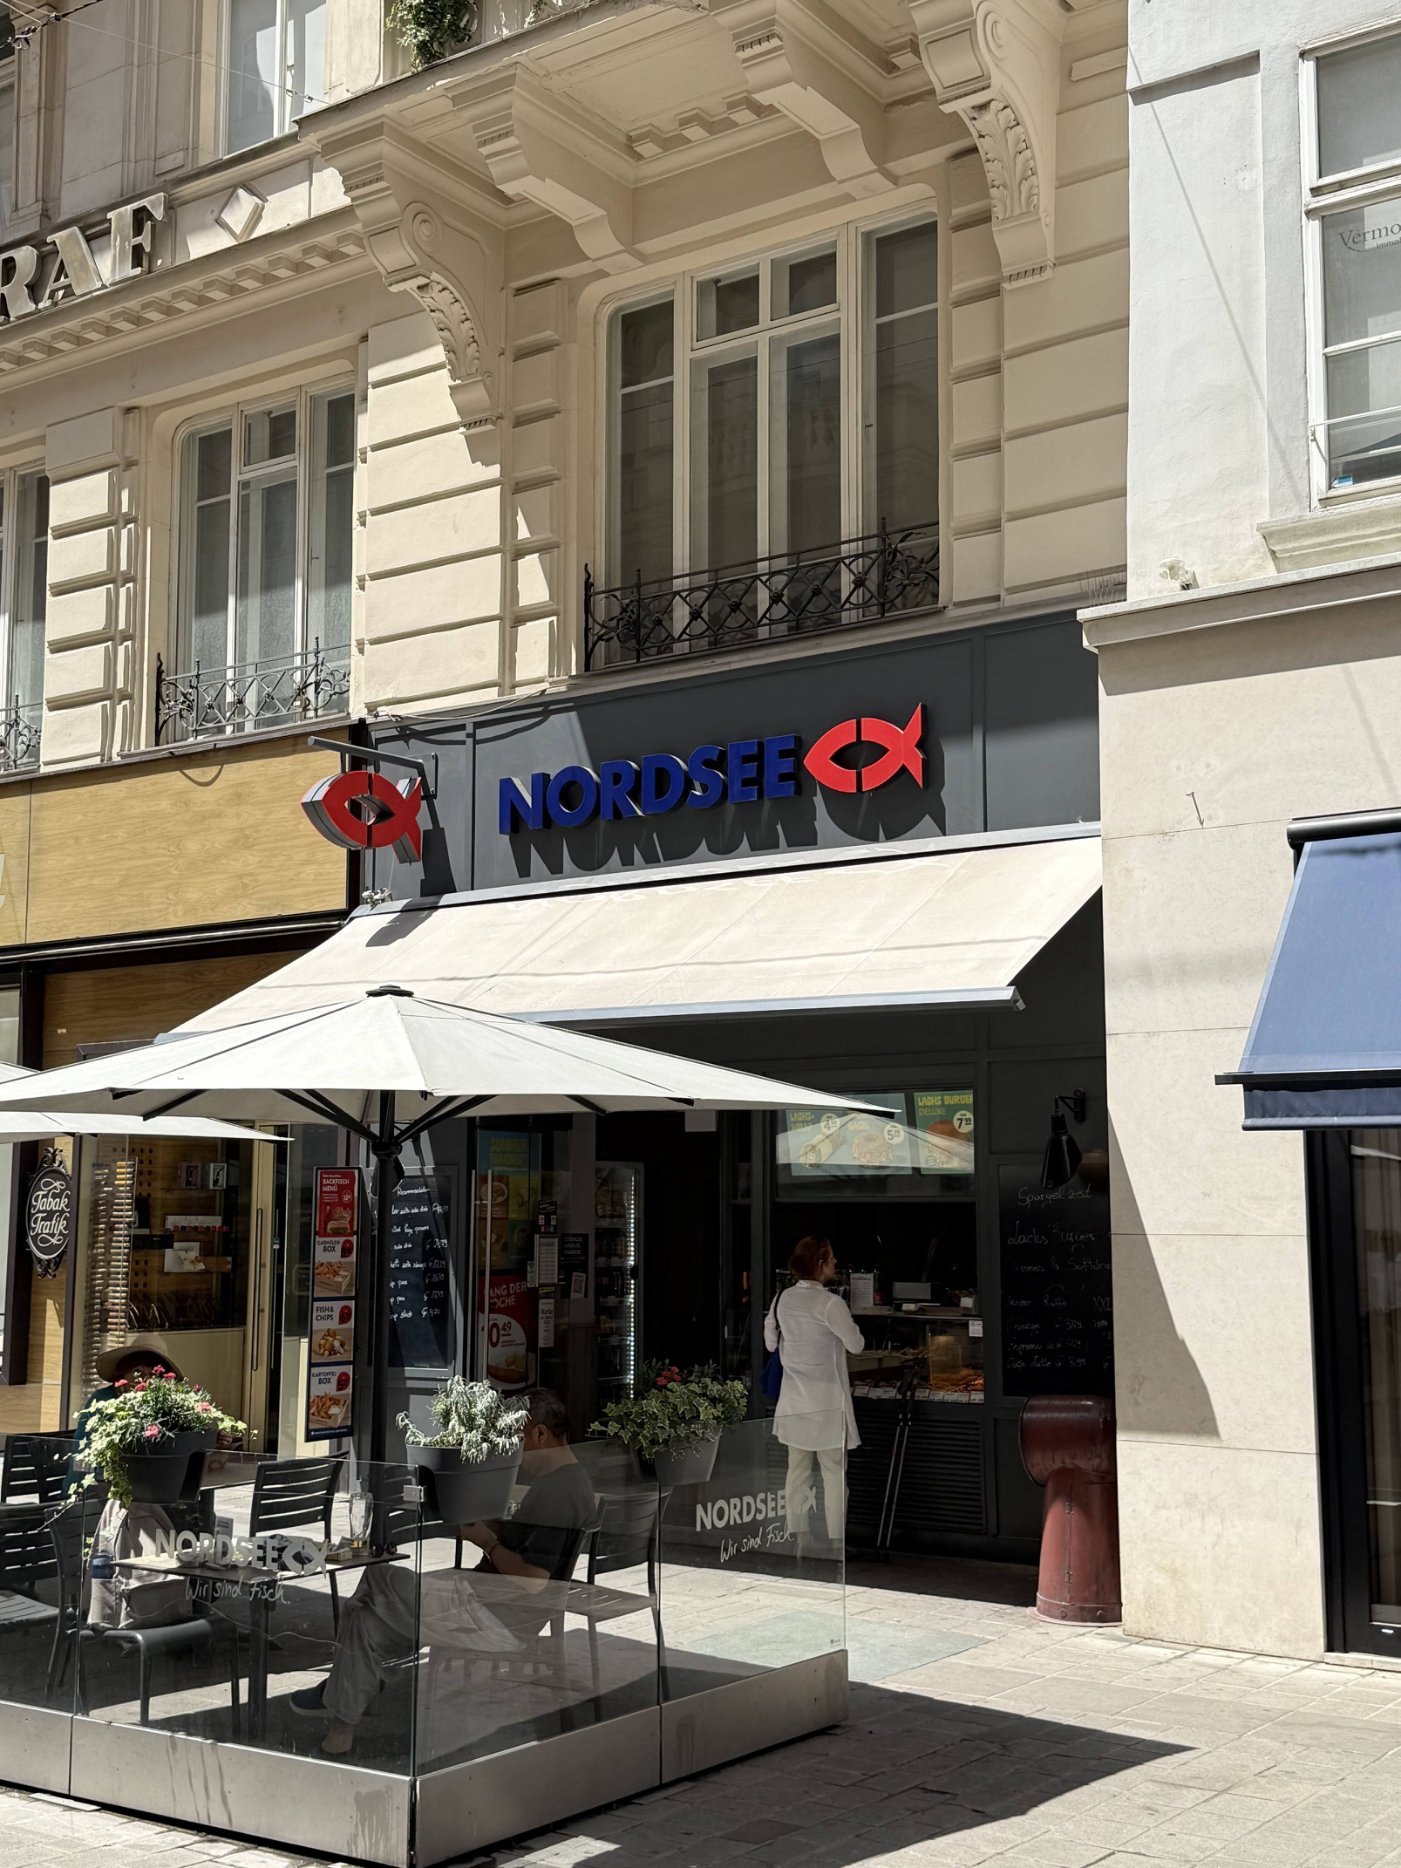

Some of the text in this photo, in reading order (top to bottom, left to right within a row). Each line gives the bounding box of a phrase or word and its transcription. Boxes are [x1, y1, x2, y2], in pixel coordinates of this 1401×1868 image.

[500, 734, 802, 835] NORDSEE
[31, 1190, 71, 1212] Tabak
[30, 1213, 70, 1236] Trafik
[696, 1488, 787, 1531] NORDSEE
[155, 1529, 279, 1571] NORDSEE
[720, 1540, 738, 1563] Wir
[741, 1526, 763, 1553] sind
[186, 1577, 208, 1600] Wir
[214, 1577, 241, 1598] sind
